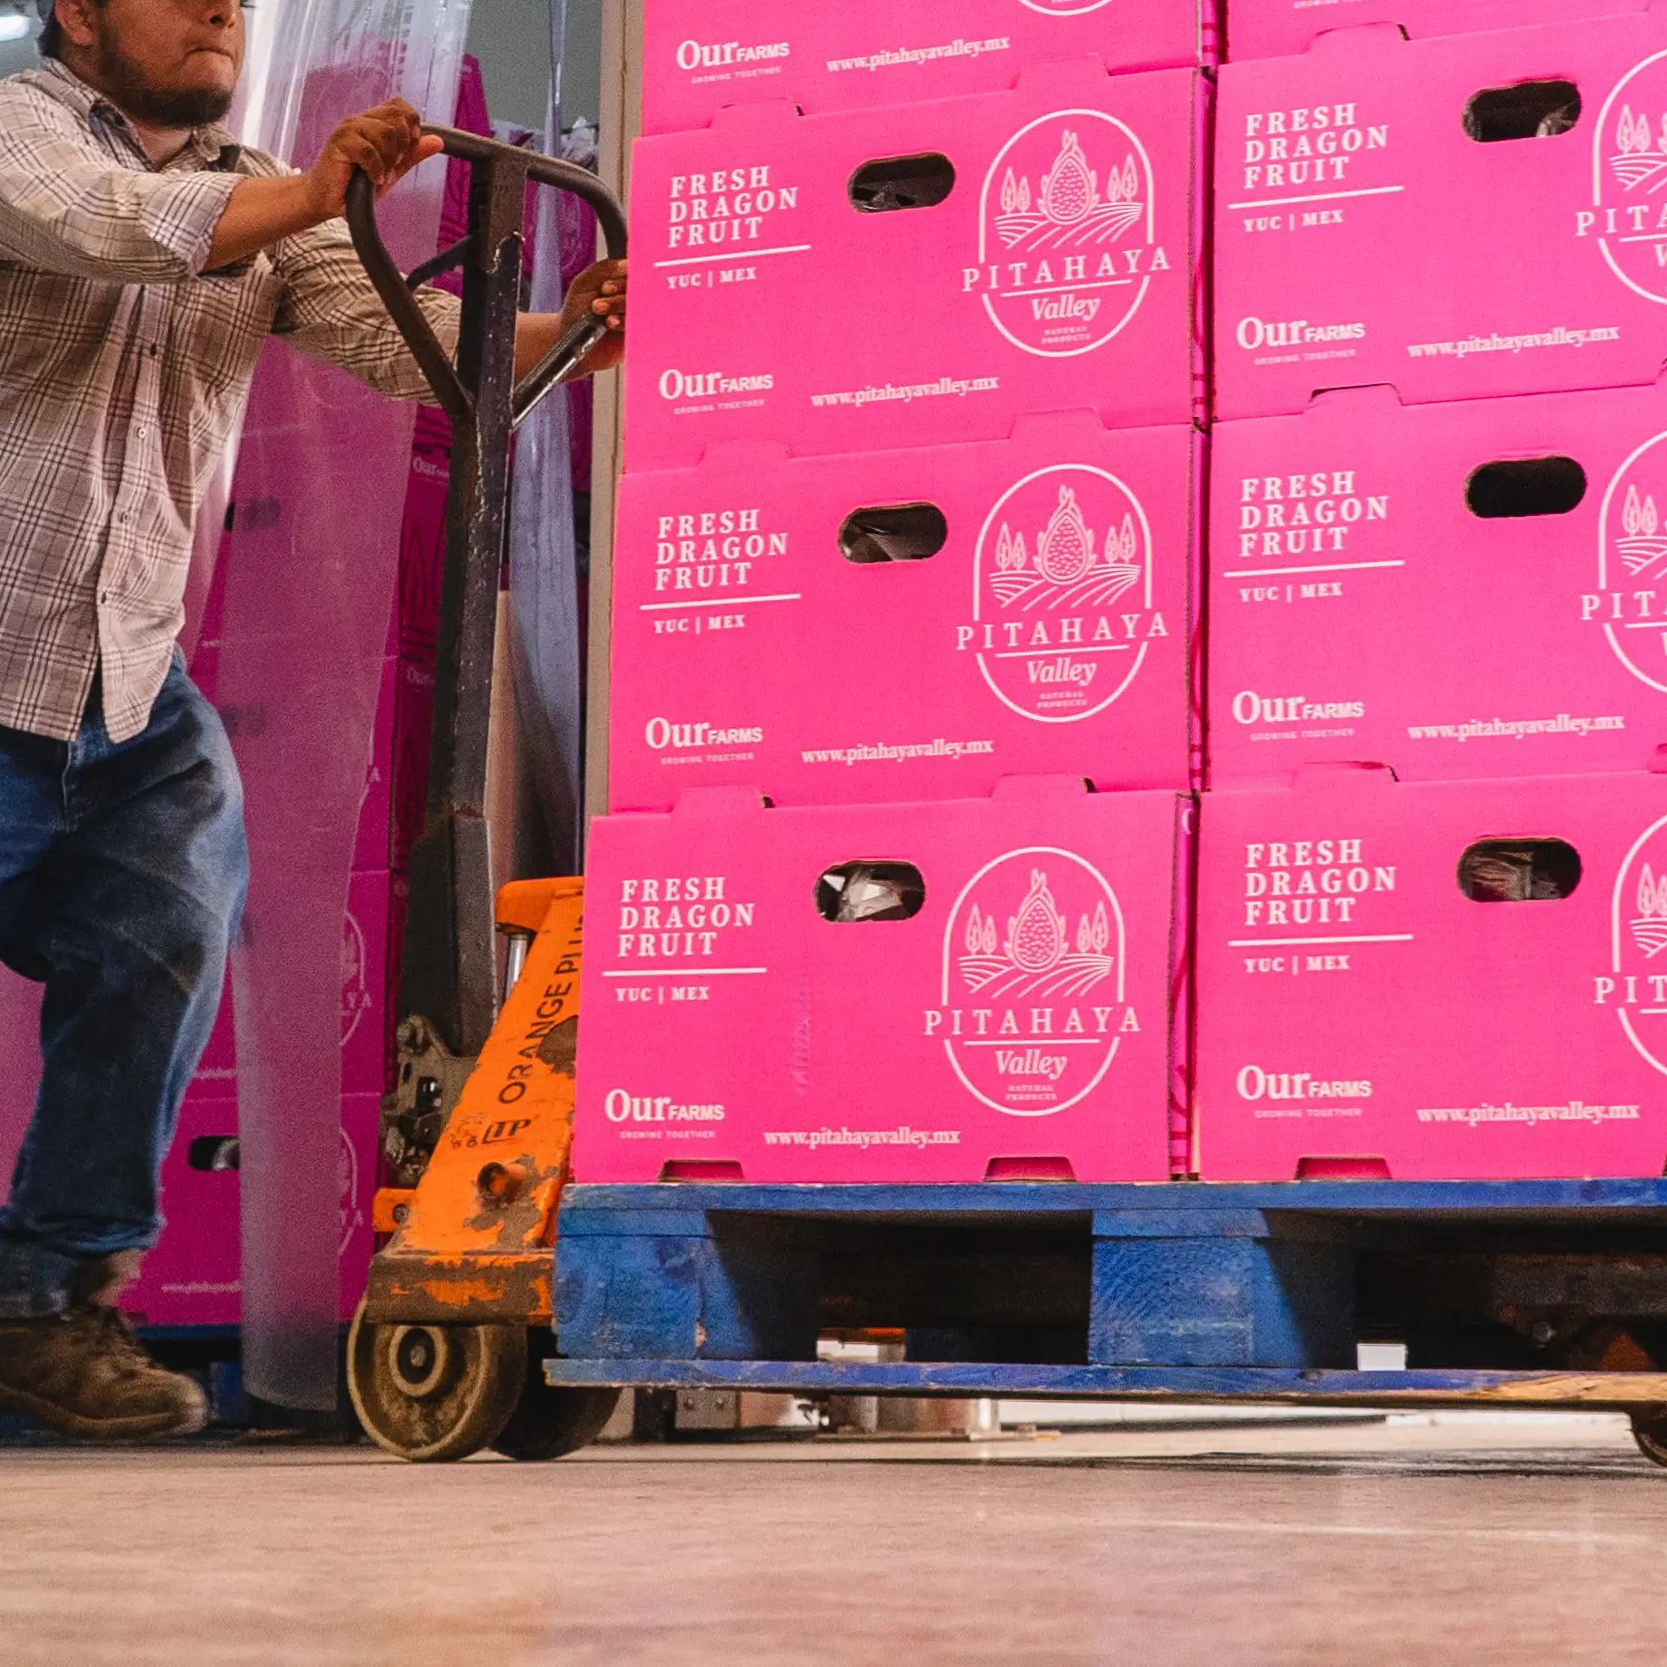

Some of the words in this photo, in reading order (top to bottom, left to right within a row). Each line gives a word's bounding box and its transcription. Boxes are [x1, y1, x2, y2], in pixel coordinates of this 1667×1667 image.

[827, 37, 1010, 71] www.pitahayavalley.mx
[1246, 103, 1356, 137] FRESH
[1245, 125, 1388, 163] DRAGON
[670, 166, 769, 198] FRESH
[1244, 156, 1349, 189] FRUIT
[669, 187, 797, 223] DRAGON
[668, 217, 762, 248] FRUIT
[1244, 216, 1281, 232] YUC
[1302, 210, 1343, 226] MEX
[667, 273, 701, 289] YUC
[720, 267, 756, 282] MEX
[962, 247, 1170, 292] PITAHAYA
[1031, 294, 1100, 321] Valley
[1407, 327, 1619, 358] www.pitahayavalley.mx
[811, 377, 999, 407] www.pitahayavalley.mx
[1241, 471, 1355, 502] FRESH
[658, 509, 759, 539] FRESH
[1240, 496, 1388, 529] DRAGON
[656, 533, 787, 564] DRAGON
[1240, 526, 1348, 557] FRUIT
[655, 562, 751, 591] FRUIT
[1240, 586, 1278, 602] YUC
[1301, 582, 1342, 598] MEX
[654, 619, 688, 633] YUC
[708, 615, 745, 629] MEX
[957, 612, 1168, 650] PITAHAYA
[1027, 657, 1097, 686] Valley
[1407, 715, 1625, 742] www.pitahayavalley.mx
[801, 740, 993, 765] www.pitahayavalley.mx
[1246, 839, 1362, 868] FRESH
[621, 877, 725, 902] FRESH
[1245, 867, 1396, 896] DRAGON
[619, 903, 754, 929] DRAGON
[1245, 897, 1356, 925] FRUIT
[618, 932, 717, 957] FRUIT
[1244, 957, 1284, 973] YUC
[1307, 955, 1349, 970] MEX
[616, 988, 651, 1001] YUC
[671, 987, 709, 1000] MEX
[924, 1007, 1141, 1035] PITAHAYA
[498, 981, 573, 1104] ORANGE
[995, 1049, 1067, 1080] Valley
[1416, 1102, 1640, 1127] www.pitahayavalley.mx
[764, 1128, 960, 1149] www.pitahayavalley.mx
